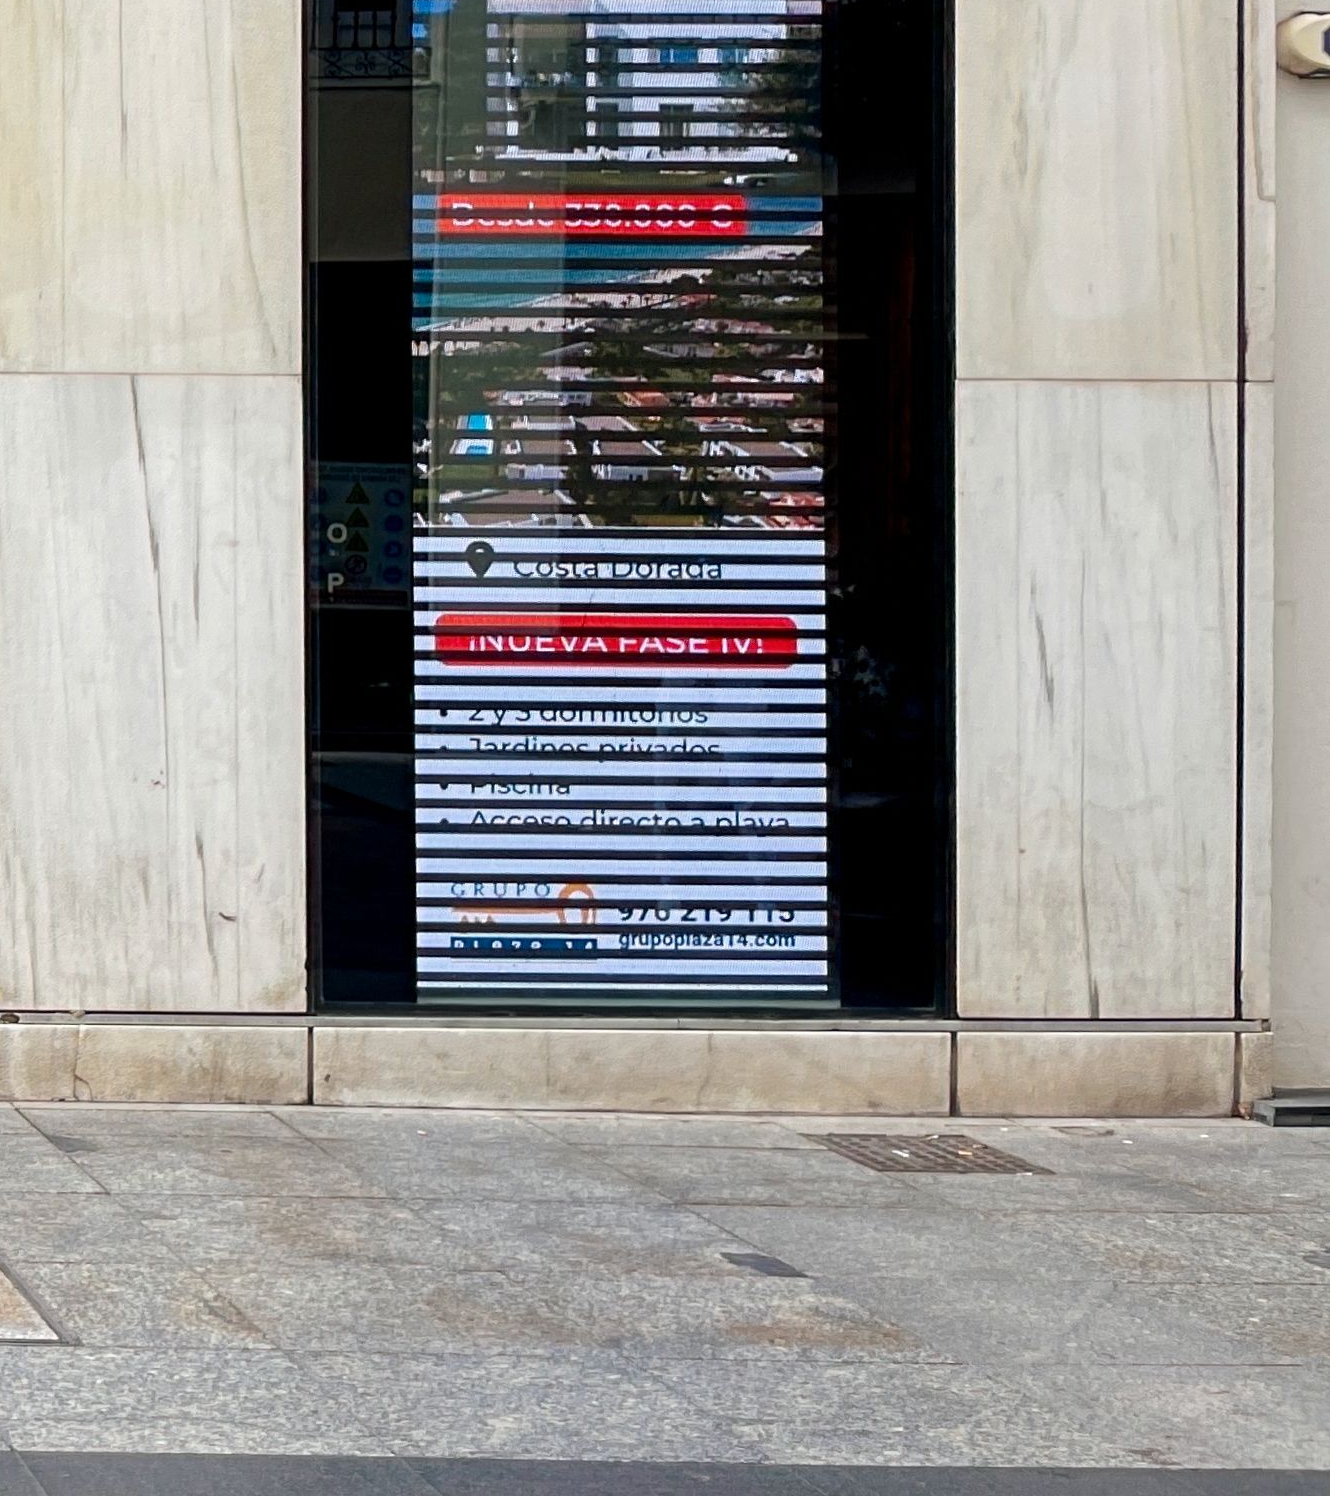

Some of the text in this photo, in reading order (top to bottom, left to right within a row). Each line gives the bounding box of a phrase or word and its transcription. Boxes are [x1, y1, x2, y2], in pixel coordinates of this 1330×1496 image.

[513, 559, 599, 578] Costa
[620, 635, 709, 654] FASE
[540, 709, 709, 725] dormitorios
[470, 810, 574, 826] Acceso
[579, 809, 682, 827] directo
[450, 882, 551, 898] GRUPO
[618, 933, 797, 950] grupoplaza14.com
